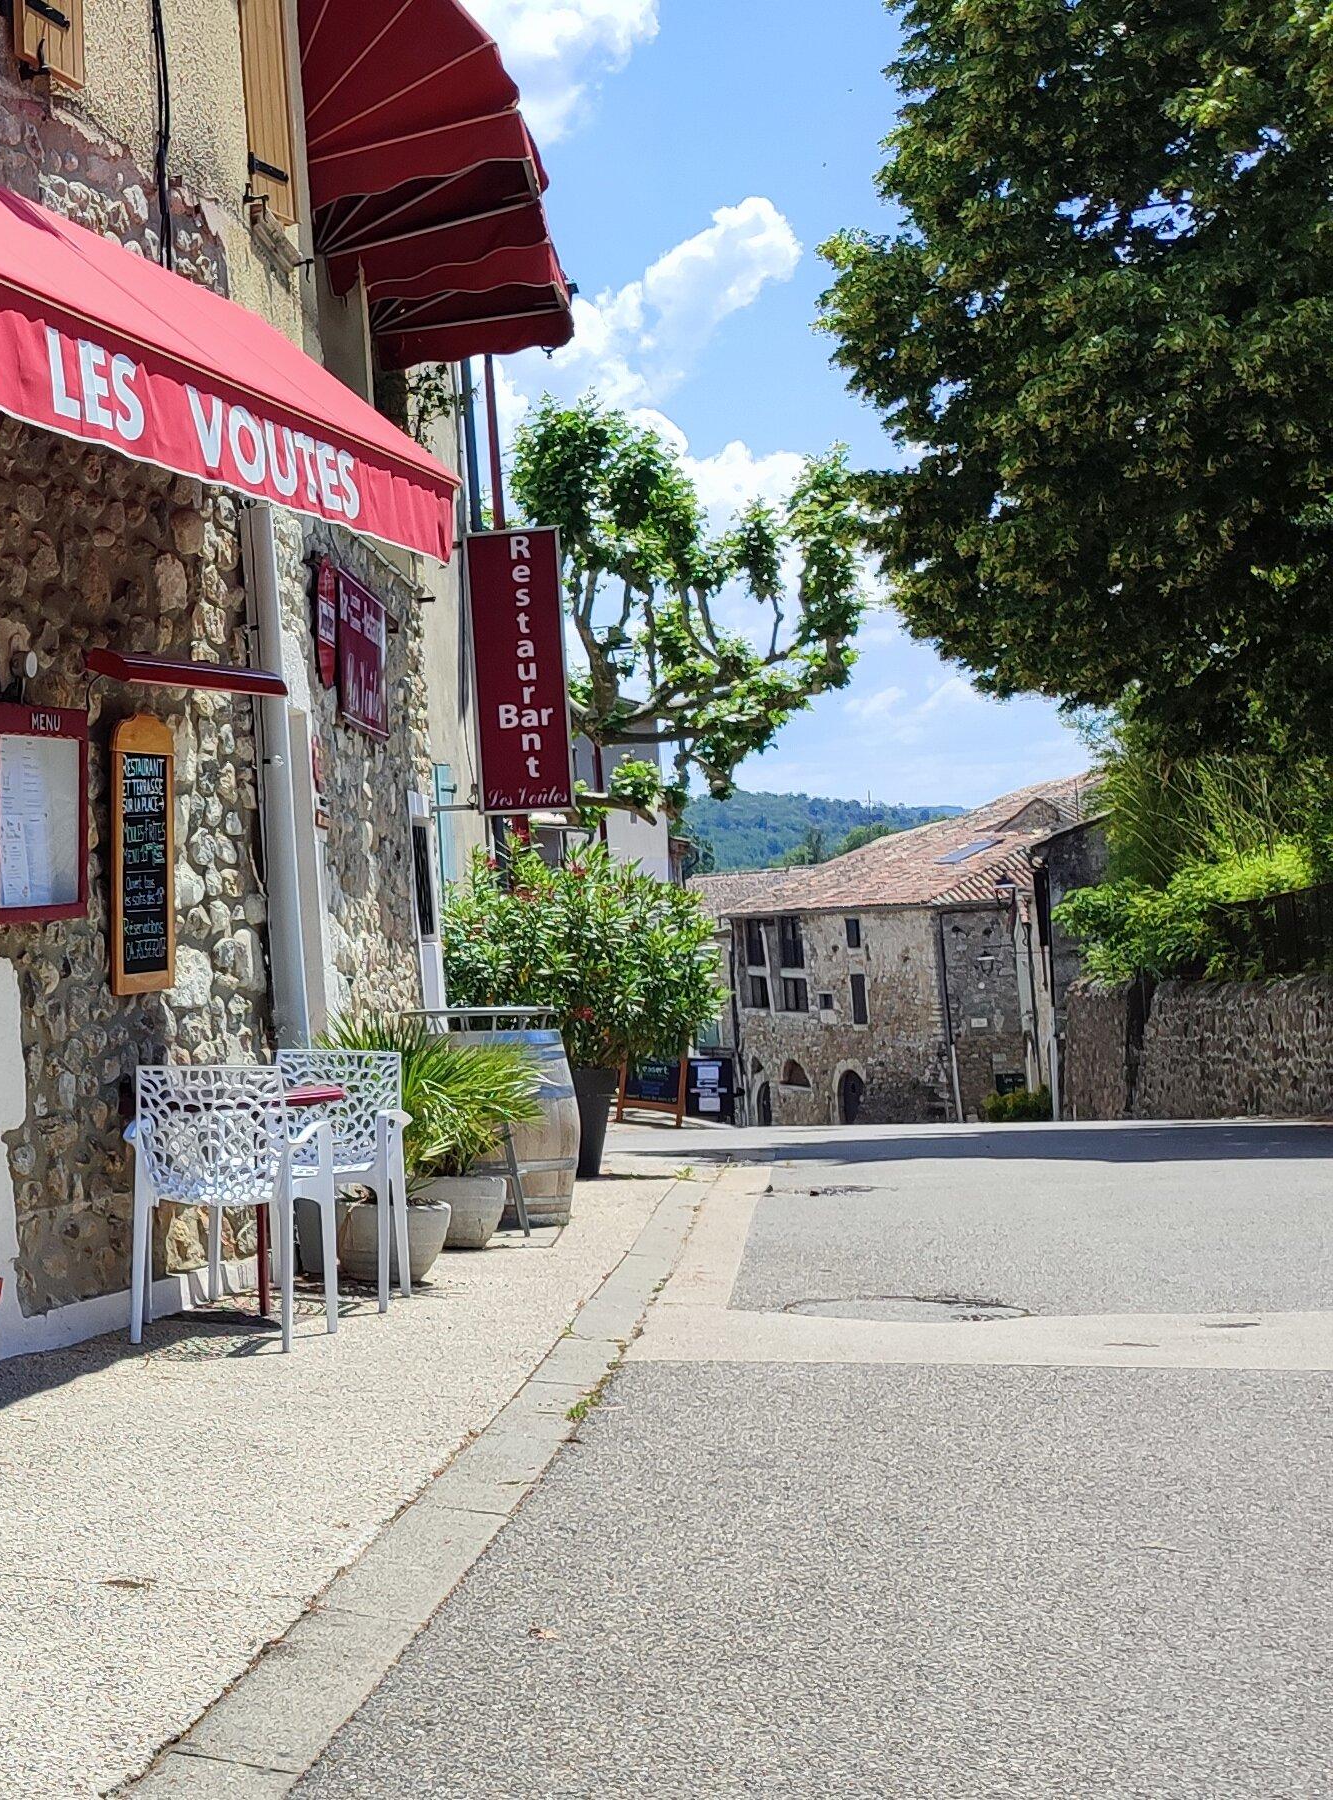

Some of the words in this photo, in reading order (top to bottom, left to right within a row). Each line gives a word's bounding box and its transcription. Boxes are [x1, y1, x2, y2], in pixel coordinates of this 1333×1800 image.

[45, 326, 145, 440] LES
[185, 383, 360, 519] VOUTES
[509, 535, 541, 778] Restaurant
[31, 713, 61, 731] MENU
[498, 704, 553, 729] Bar
[488, 789, 513, 806] Les
